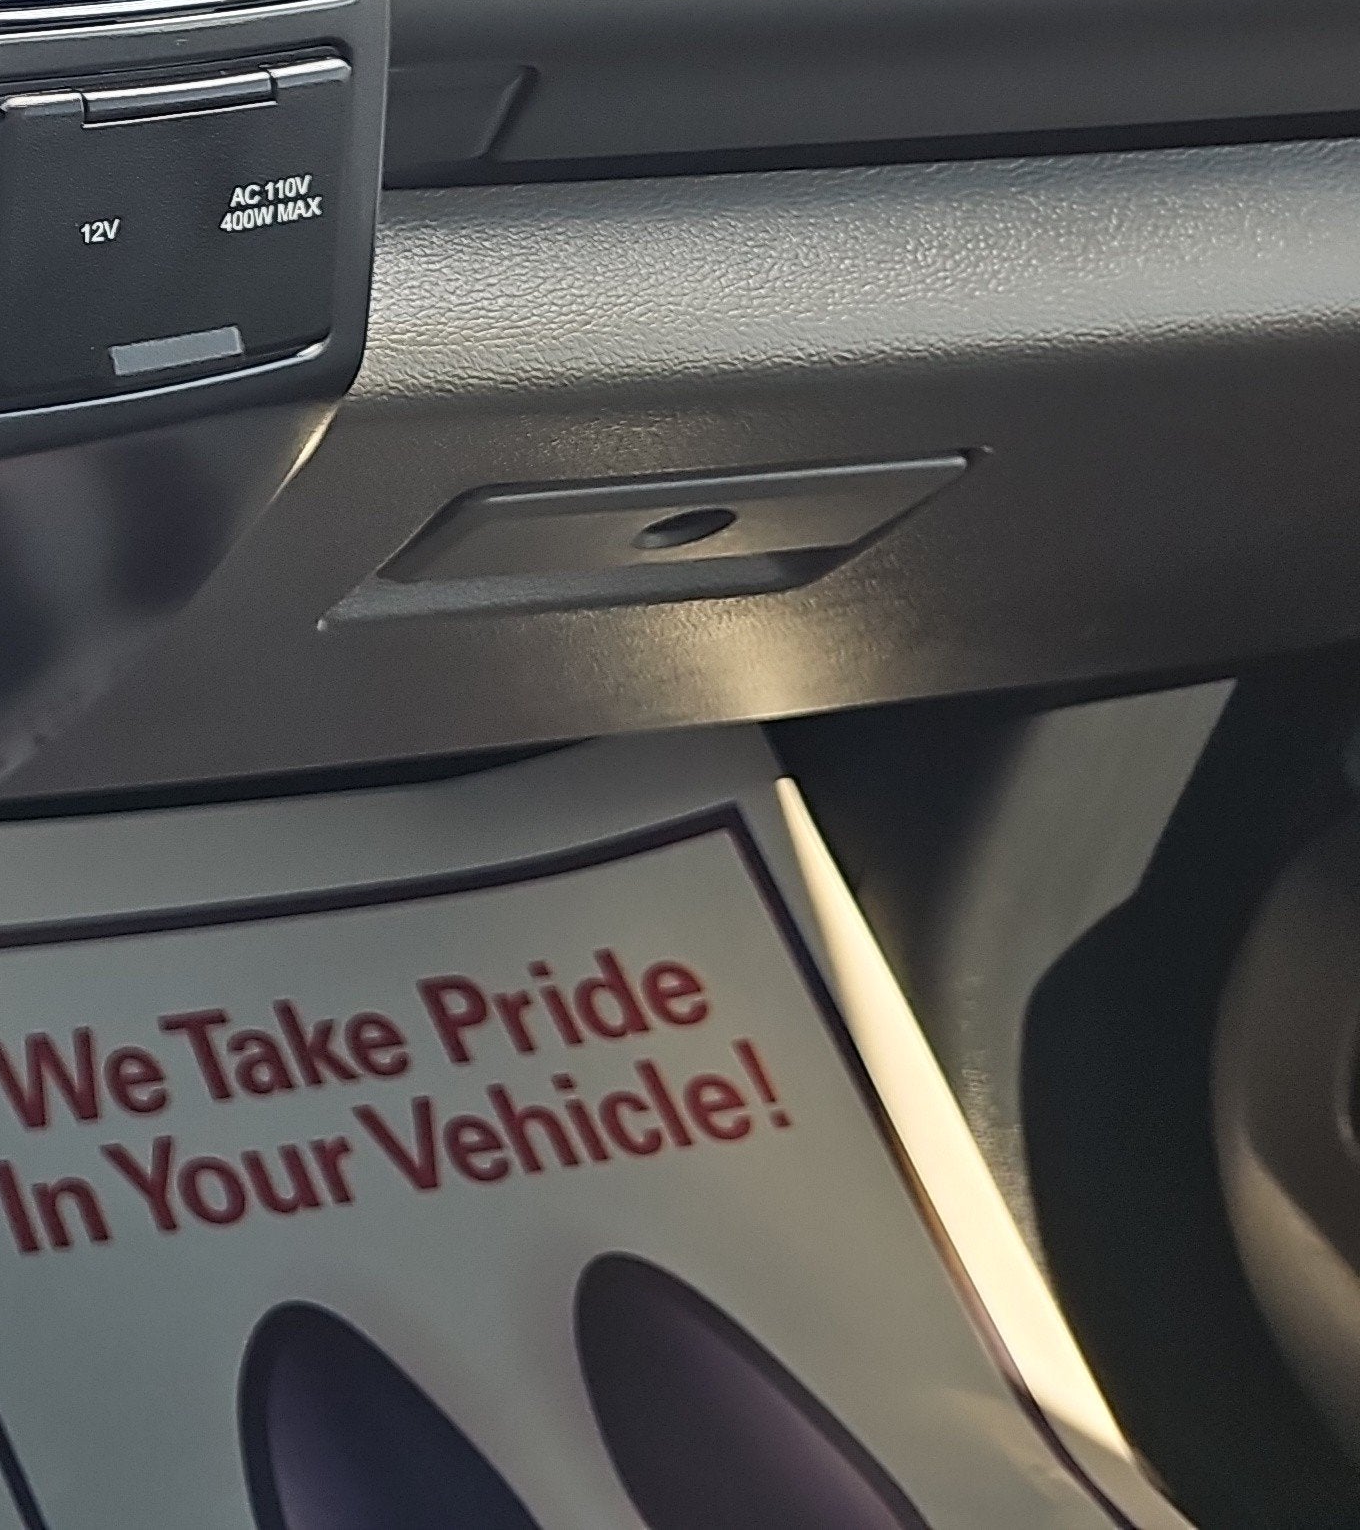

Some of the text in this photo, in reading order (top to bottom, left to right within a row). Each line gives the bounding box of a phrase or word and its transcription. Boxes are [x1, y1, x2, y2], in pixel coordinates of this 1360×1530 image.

[230, 175, 312, 208] AC 110V
[81, 219, 119, 243] 12V
[220, 196, 322, 232] 400W MAX
[160, 999, 409, 1102] Take
[416, 949, 710, 1063] Pride
[101, 1130, 355, 1232] Your
[353, 1038, 791, 1192] Vehicle!
